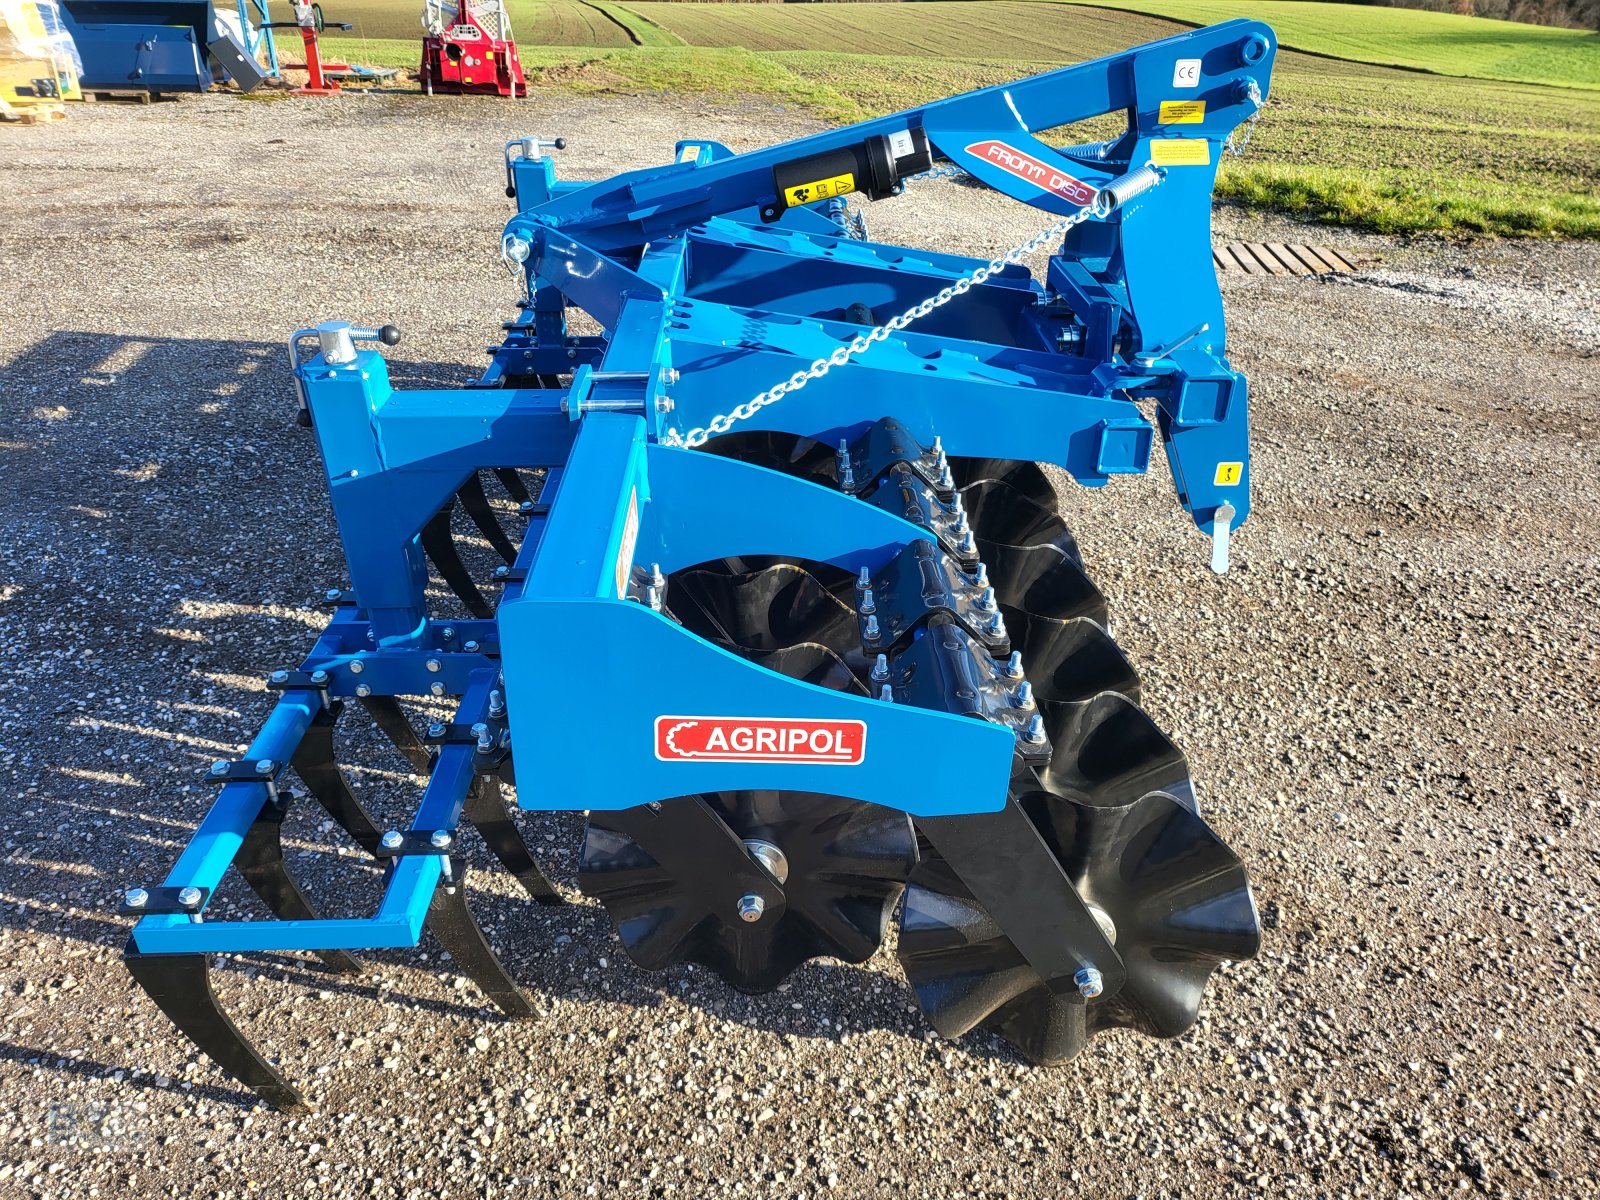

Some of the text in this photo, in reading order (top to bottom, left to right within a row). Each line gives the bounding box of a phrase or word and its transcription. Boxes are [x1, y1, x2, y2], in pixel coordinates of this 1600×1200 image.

[1178, 66, 1195, 79] CE
[987, 145, 1088, 202] FRONT DISC
[705, 727, 853, 754] AGRIPOL
